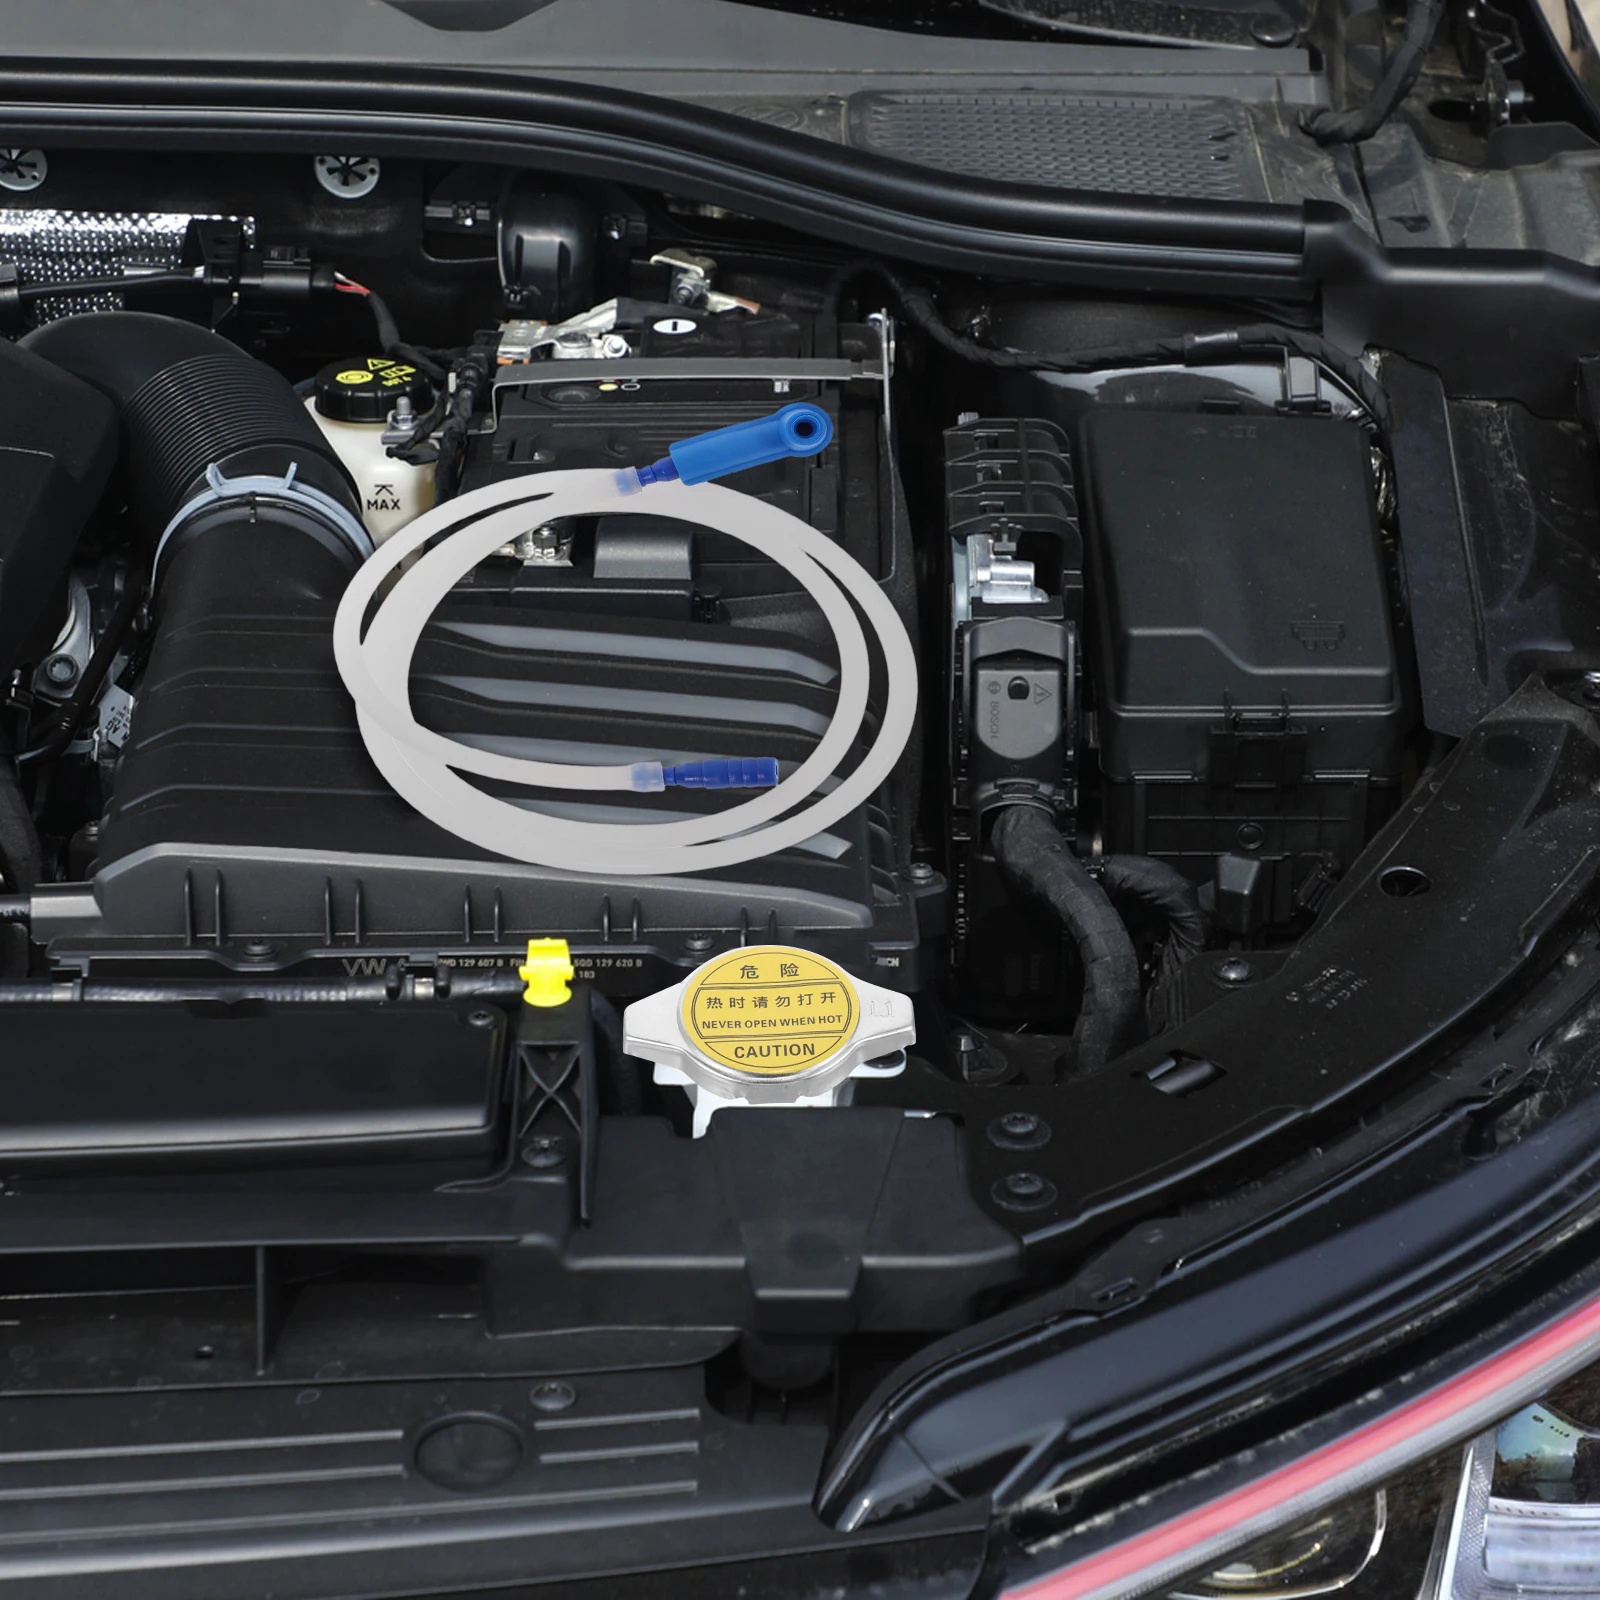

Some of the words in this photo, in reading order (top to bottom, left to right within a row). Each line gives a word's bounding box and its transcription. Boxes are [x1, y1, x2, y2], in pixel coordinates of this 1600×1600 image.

[367, 499, 401, 510] MAX
[990, 700, 1000, 739] BOSCH
[342, 958, 387, 977] VW
[459, 958, 476, 968] 129
[478, 958, 495, 968] 607
[596, 959, 613, 968] 129
[615, 959, 634, 968] 620
[740, 963, 799, 979] 危险
[706, 991, 836, 1009] 热时请勿打开
[702, 1020, 742, 1029] NEVER
[744, 1019, 777, 1028] OPEN
[779, 1016, 816, 1027] WHEN
[818, 1014, 843, 1024] HOT
[734, 1043, 815, 1059] CAUTION
